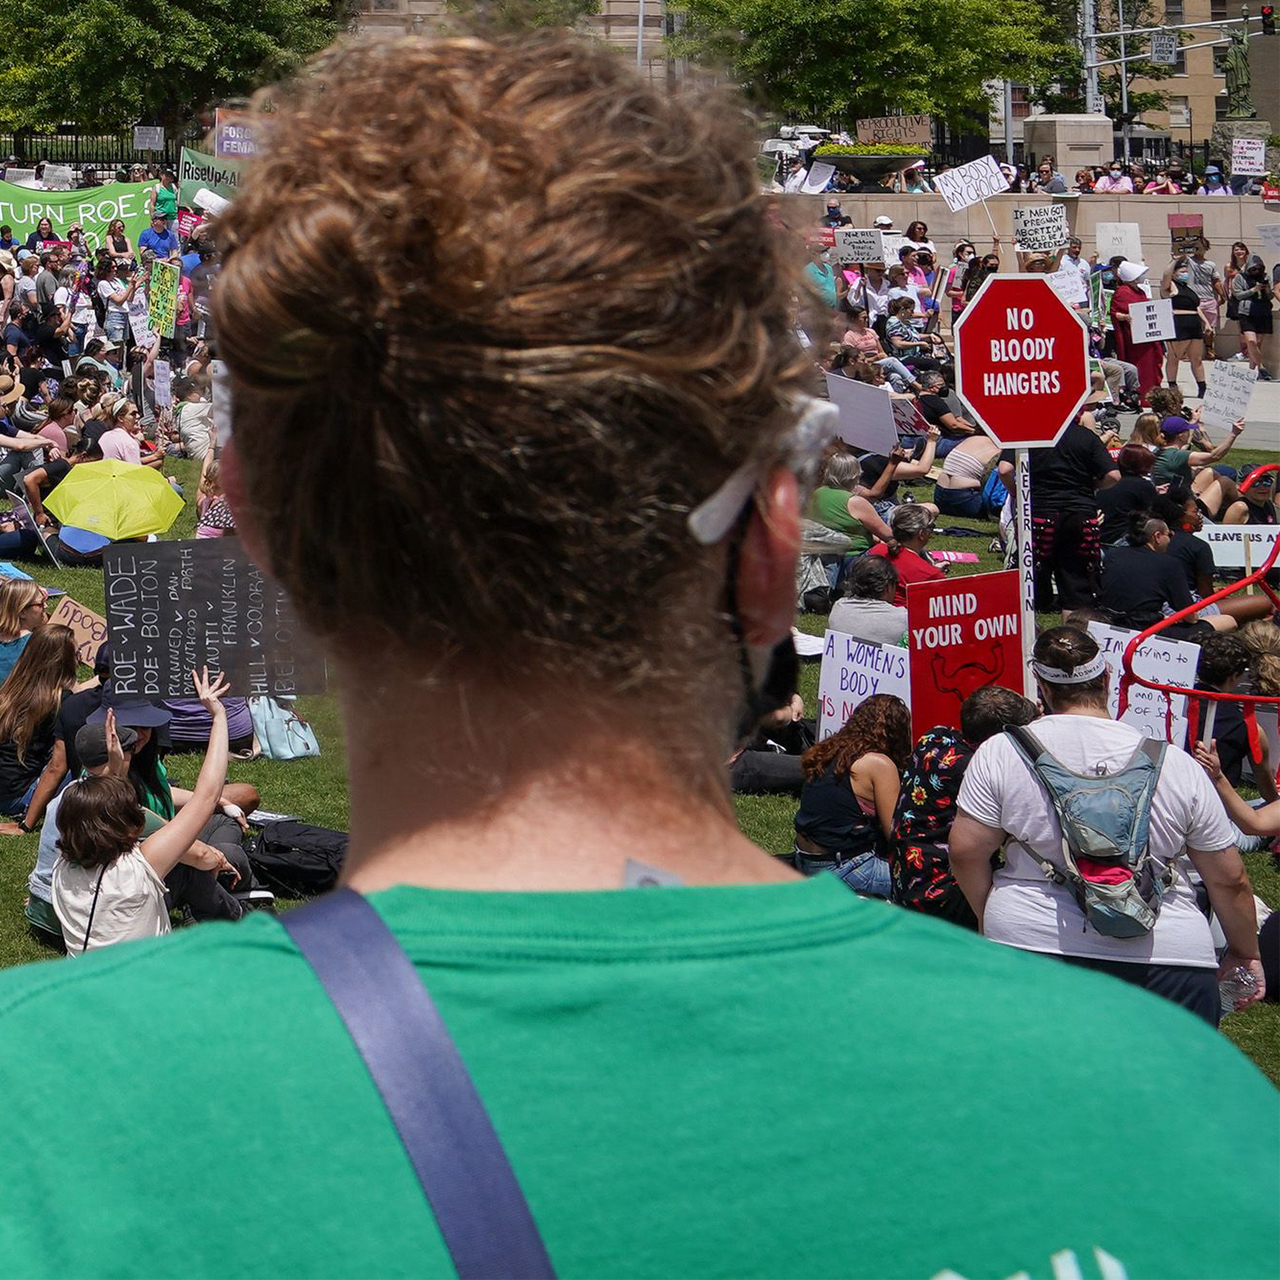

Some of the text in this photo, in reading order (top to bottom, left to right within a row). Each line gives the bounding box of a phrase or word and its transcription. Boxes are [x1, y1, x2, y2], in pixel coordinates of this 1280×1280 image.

[1153, 35, 1166, 43] LEFT
[857, 116, 928, 130] REPRODUCTIVE
[873, 127, 917, 140] RIGHTS
[183, 161, 241, 188] RiseUp4A
[939, 157, 997, 194] MY BODY
[947, 173, 1006, 208] MY CHOICE
[1013, 205, 1065, 220] IF MEN GOT
[1023, 215, 1063, 227] PREGNANT
[1015, 226, 1063, 237] ABORTION
[1016, 231, 1065, 245] WOULD BE A
[1112, 236, 1123, 244] MY
[1019, 240, 1052, 251] SACRED
[1006, 307, 1034, 331] NO
[1146, 305, 1155, 313] MY
[1145, 330, 1162, 338] CHOICE
[1148, 322, 1157, 330] MY
[990, 337, 1056, 363] BLOODY
[983, 371, 1061, 397] HANGERS
[1020, 460, 1034, 612] NEVER AGAIN
[1208, 532, 1263, 542] LEAVE US
[107, 555, 136, 631] WADE
[168, 571, 179, 601] DAN-
[140, 560, 160, 640] BOLTON
[221, 558, 238, 646] FRANKLIN
[929, 592, 977, 618] MIND
[58, 599, 108, 641] Body
[180, 548, 198, 695] PARENTHOOD FORTH
[912, 613, 1018, 650] YOUR OWN
[168, 627, 183, 696] PLANNED
[825, 634, 905, 678] A WOMENS
[1175, 653, 1189, 664] to
[112, 652, 138, 695] ROE
[143, 657, 160, 695] DOE
[249, 654, 269, 695] HILL
[840, 667, 880, 696] BODY
